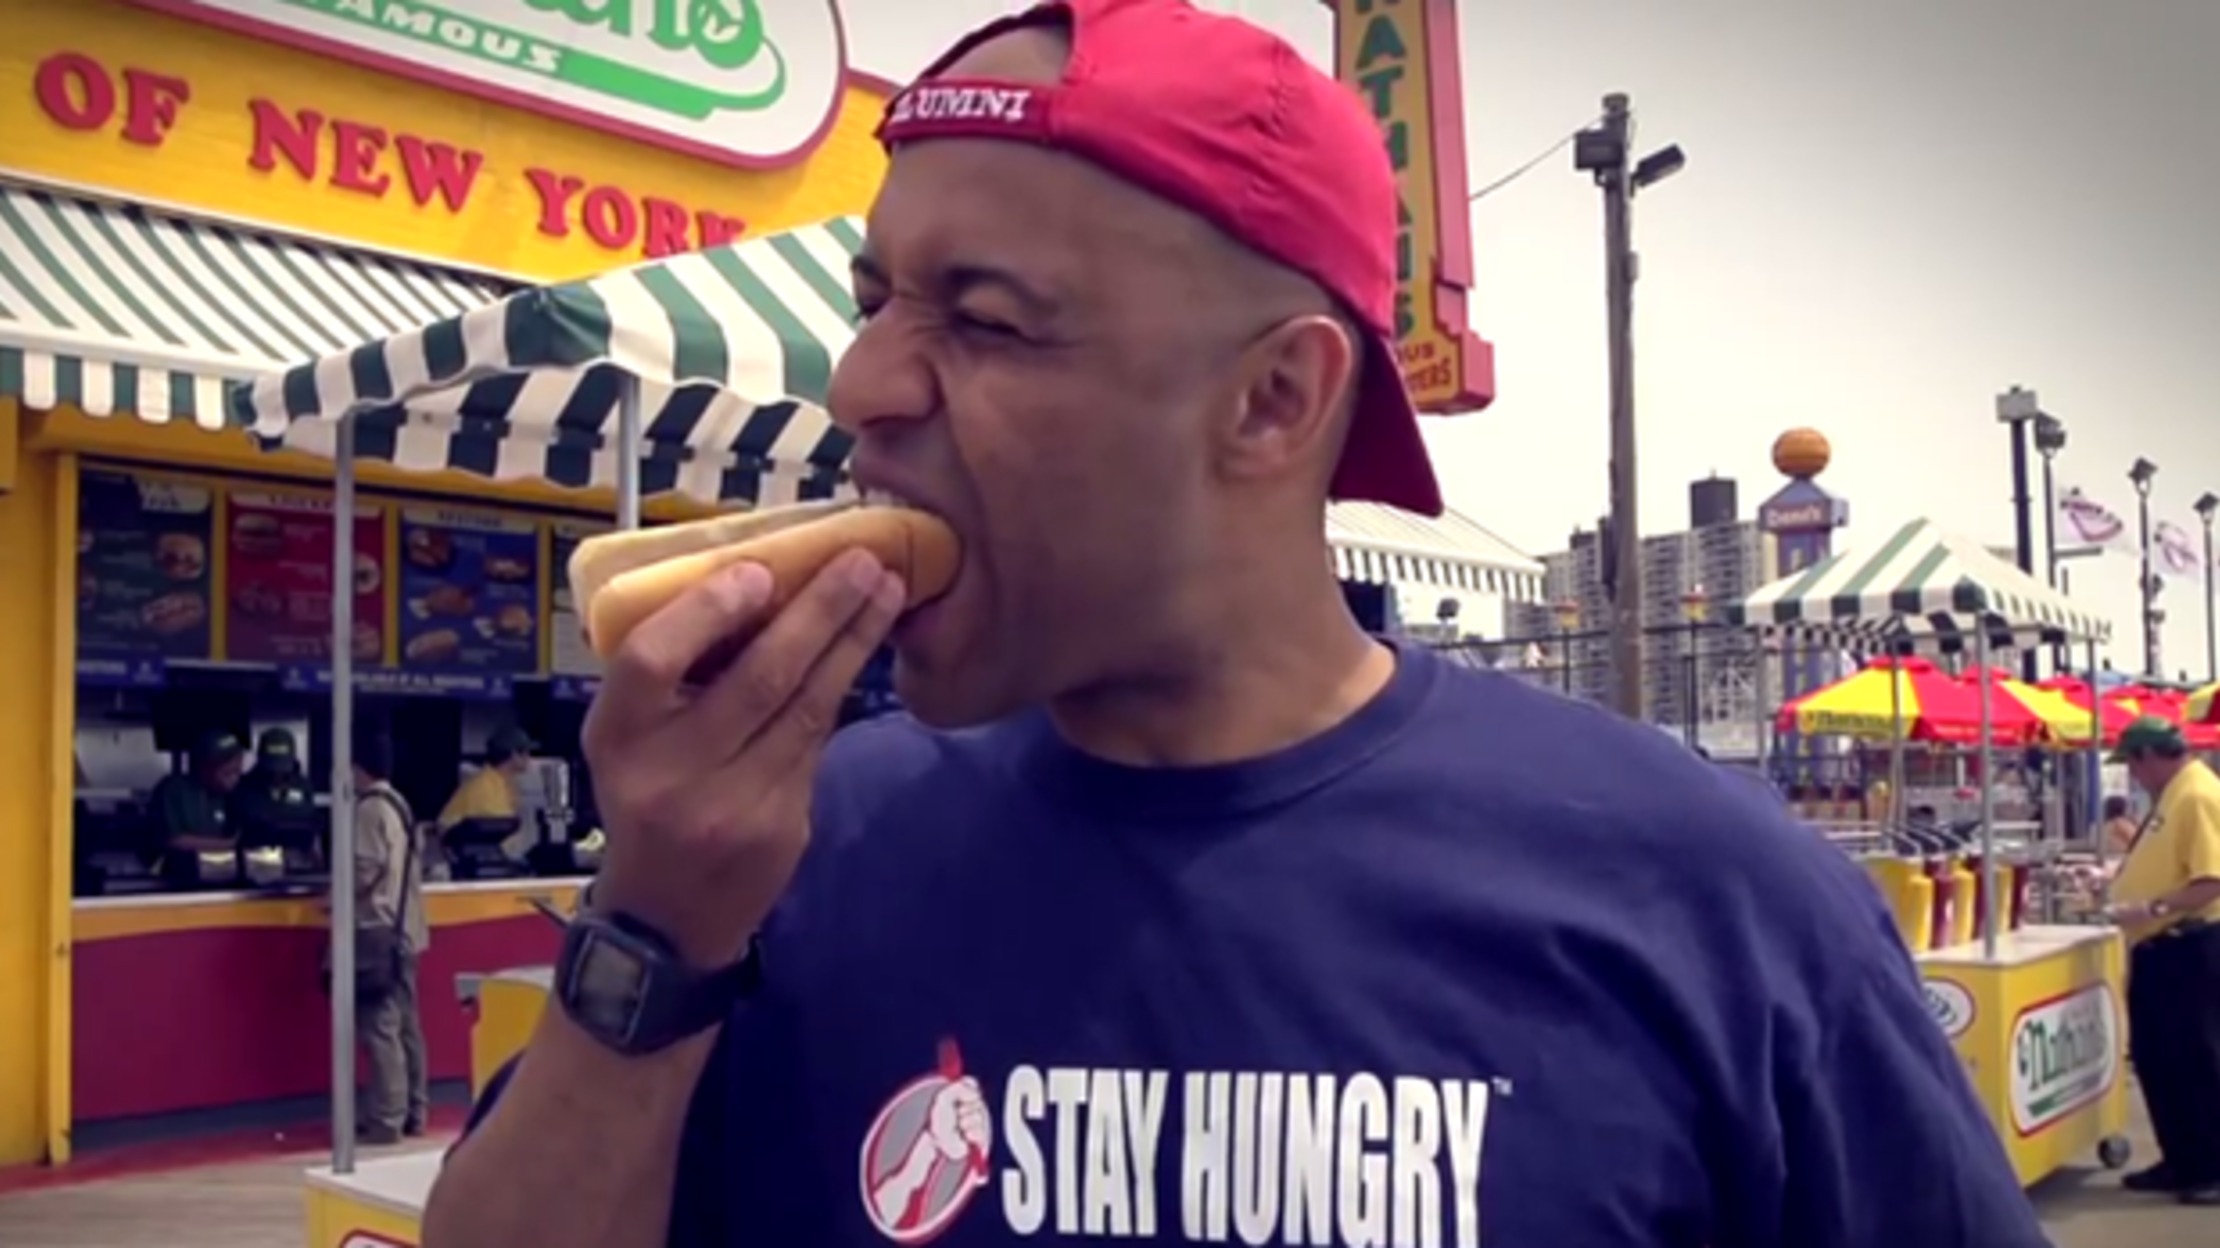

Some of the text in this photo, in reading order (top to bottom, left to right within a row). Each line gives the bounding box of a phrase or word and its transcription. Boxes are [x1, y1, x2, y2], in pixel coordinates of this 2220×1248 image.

[328, 0, 562, 73] AMOUS
[34, 52, 190, 146] OF
[247, 99, 484, 213] NEW
[891, 87, 1031, 124] LUMNI
[1002, 1065, 1168, 1235] STAY
[1182, 1072, 1488, 1248] HUNGRY
